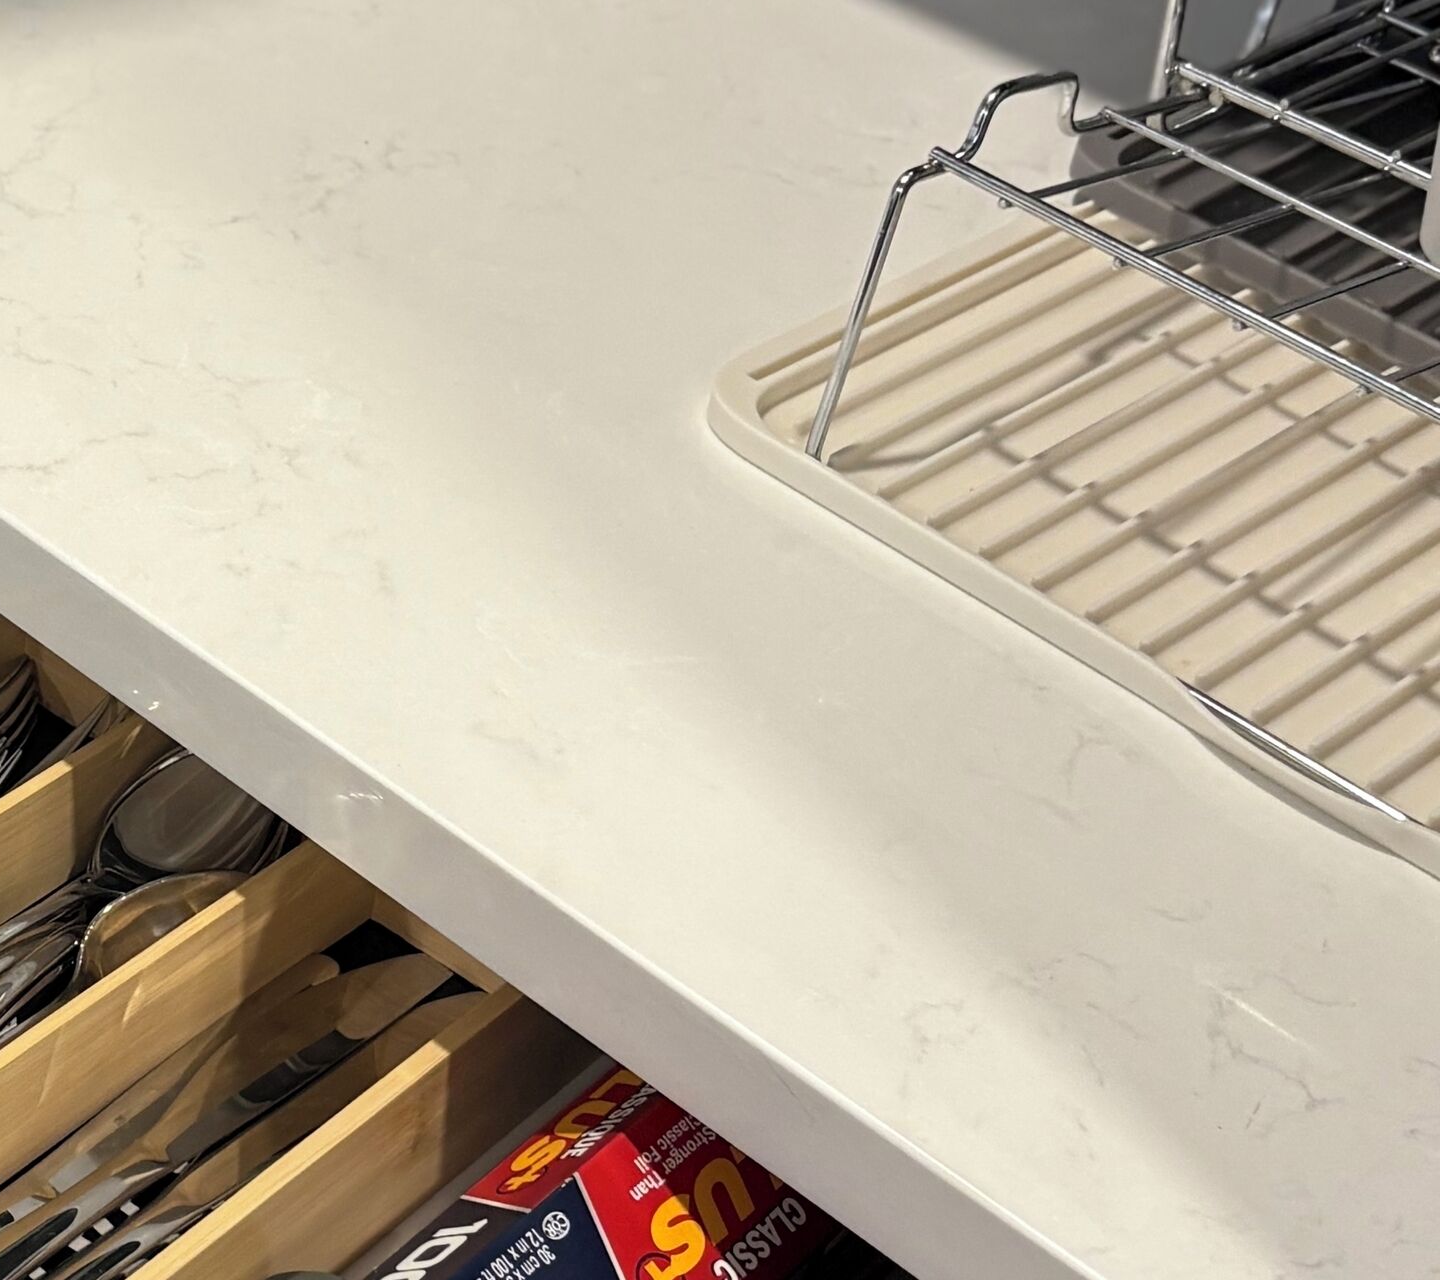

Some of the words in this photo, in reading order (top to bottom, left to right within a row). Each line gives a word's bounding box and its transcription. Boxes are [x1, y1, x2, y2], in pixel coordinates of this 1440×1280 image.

[633, 1144, 662, 1175] Foil
[663, 1125, 717, 1176] Stronger
[628, 1169, 667, 1201] Than
[514, 1239, 534, 1256] in
[524, 1228, 545, 1246] 12
[507, 1249, 519, 1262] x
[537, 1244, 557, 1265] 30
[490, 1254, 514, 1279] 100
[519, 1258, 541, 1278] cm
